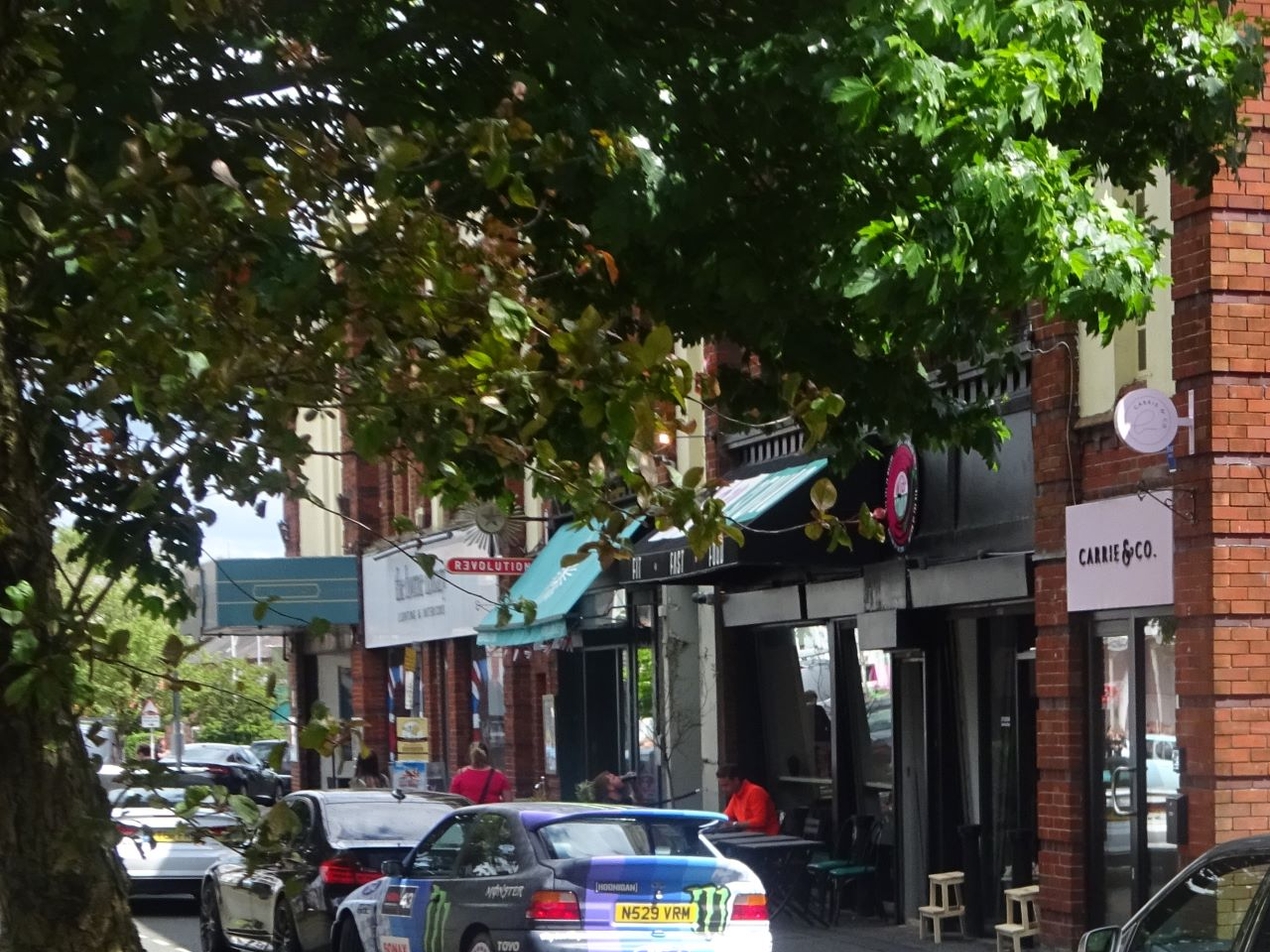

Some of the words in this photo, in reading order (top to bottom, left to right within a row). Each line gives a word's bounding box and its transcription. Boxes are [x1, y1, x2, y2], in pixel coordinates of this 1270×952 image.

[669, 549, 685, 576] FAST
[621, 906, 660, 920] N529
[664, 906, 690, 920] VRM
[497, 941, 520, 952] TOYO
